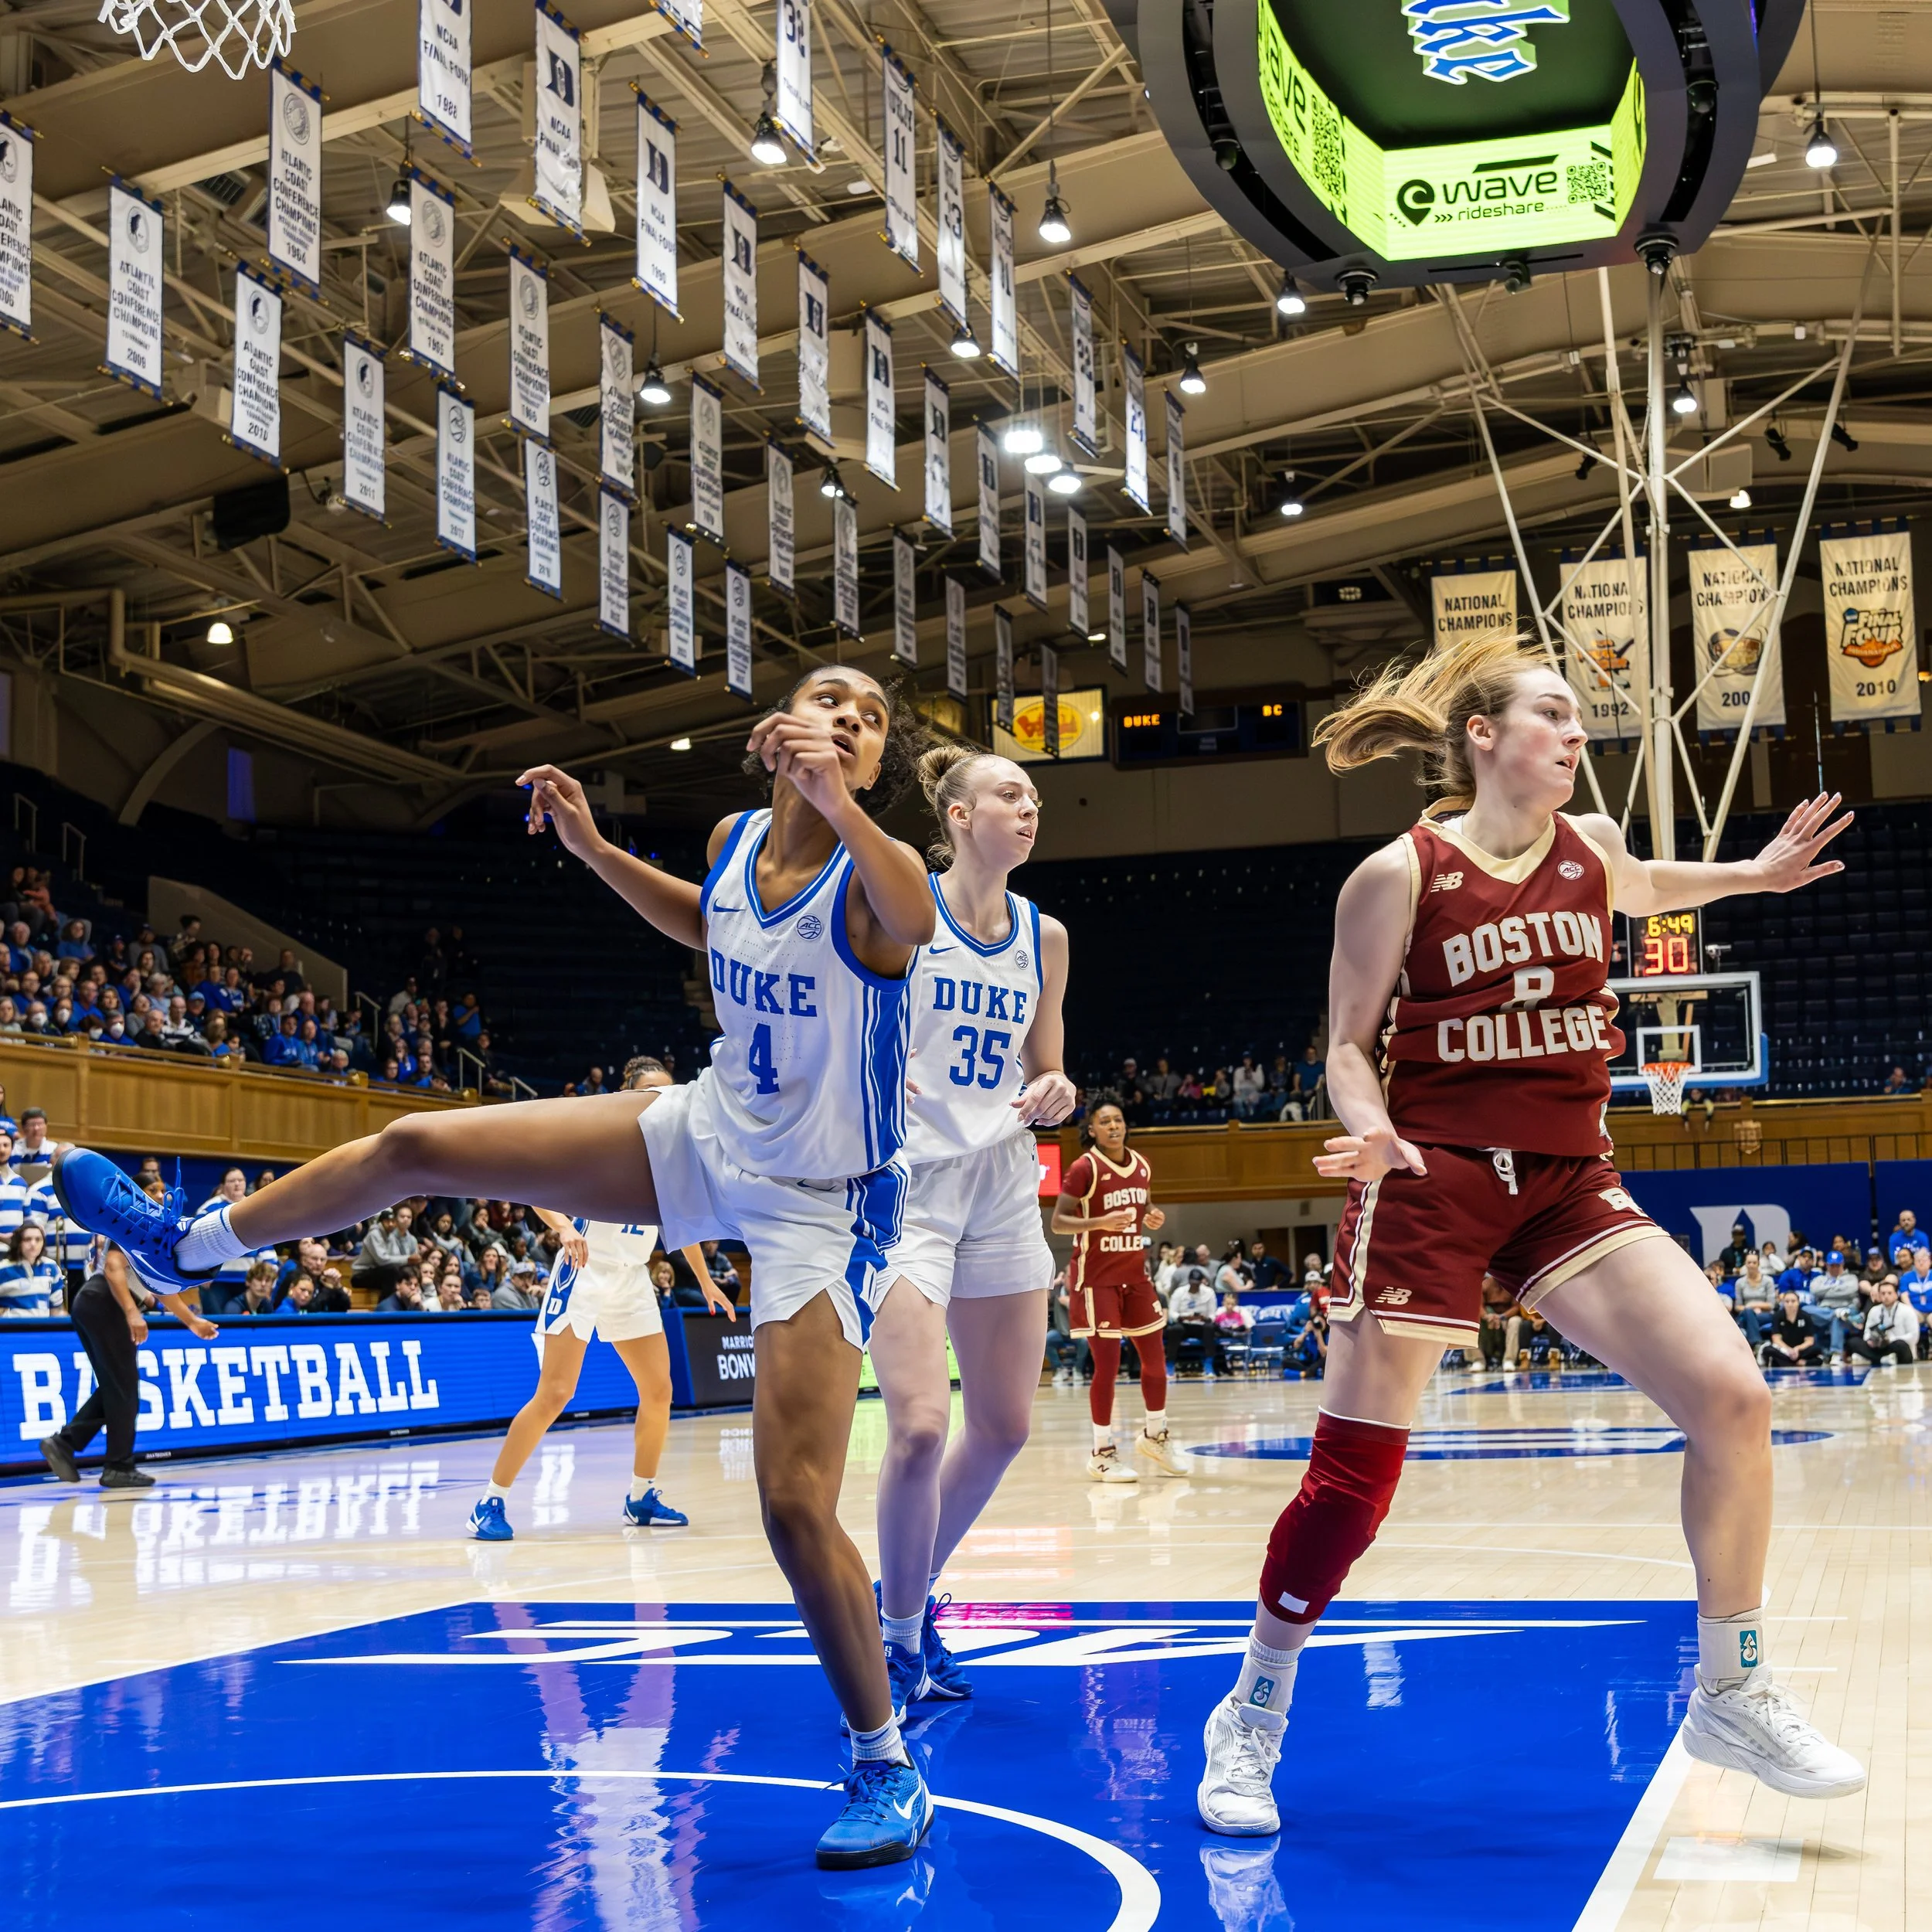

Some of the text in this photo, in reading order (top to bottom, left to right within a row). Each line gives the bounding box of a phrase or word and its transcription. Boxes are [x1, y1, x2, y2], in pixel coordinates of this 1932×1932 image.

[436, 23, 459, 53] NCAA
[423, 39, 469, 87] FINAL FOUR
[551, 116, 571, 142] NCAA
[281, 148, 312, 182] ATLANTIC
[284, 168, 308, 193] COAST
[1443, 170, 1558, 205] wave
[274, 177, 319, 220] CONFERENCE
[276, 196, 317, 236] CHAMPIONS
[1458, 202, 1545, 221] rideshare
[641, 218, 658, 243] FINAL
[120, 260, 155, 290] ATLANTIC
[127, 279, 150, 302] COAST
[112, 289, 161, 326] CONFERENCE
[114, 307, 158, 341] CHAMPIONS
[250, 357, 269, 379] COAST
[237, 366, 279, 402] CONFERENCE
[247, 421, 269, 442] 2010
[1835, 556, 1899, 577] NATIONAL
[1574, 581, 1629, 600] NATIONA
[1829, 575, 1908, 597] CHAMPIONS
[1444, 594, 1506, 612] NATIONAL
[1567, 600, 1645, 619] CHAMPIO
[1437, 611, 1513, 632] CHAMPIONS
[1858, 609, 1901, 628] FINAL
[1841, 624, 1903, 648] FOUR
[1722, 691, 1751, 707] 200
[1856, 679, 1896, 697] 2010
[1124, 714, 1161, 729] DUKE
[1262, 704, 1283, 717] BC
[1591, 702, 1630, 719] 1992
[800, 921, 821, 930] ACC
[1647, 914, 1693, 937] 6:49
[1442, 910, 1604, 988] BOSTON
[1645, 937, 1689, 975] 30
[710, 947, 818, 1018] DUKE
[933, 976, 1028, 1025] DUKE
[1437, 1005, 1612, 1063] COLLEGE
[748, 1023, 781, 1095] 4
[948, 1025, 1012, 1090] 35
[547, 1298, 563, 1315] D
[722, 1335, 755, 1350] MARRIO
